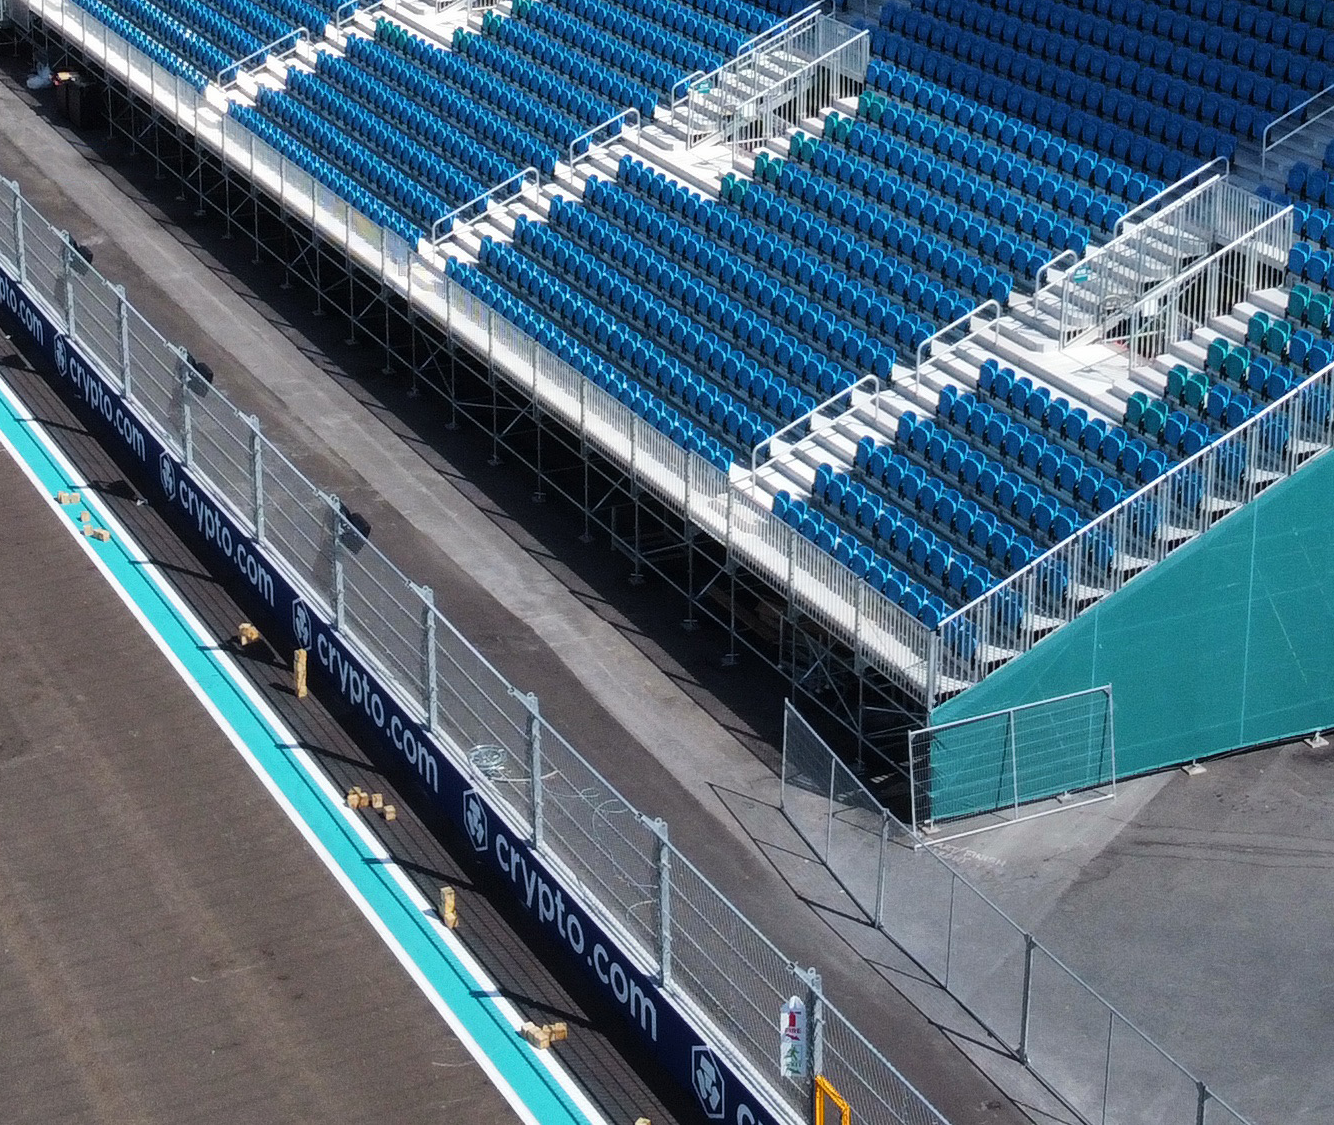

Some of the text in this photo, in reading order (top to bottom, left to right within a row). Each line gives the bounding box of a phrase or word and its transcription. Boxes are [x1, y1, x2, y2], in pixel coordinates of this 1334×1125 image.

[69, 356, 146, 463] crypto.com
[178, 479, 276, 608] crypto.com
[316, 633, 439, 794] crypto.com
[495, 833, 658, 1043] crypto.com
